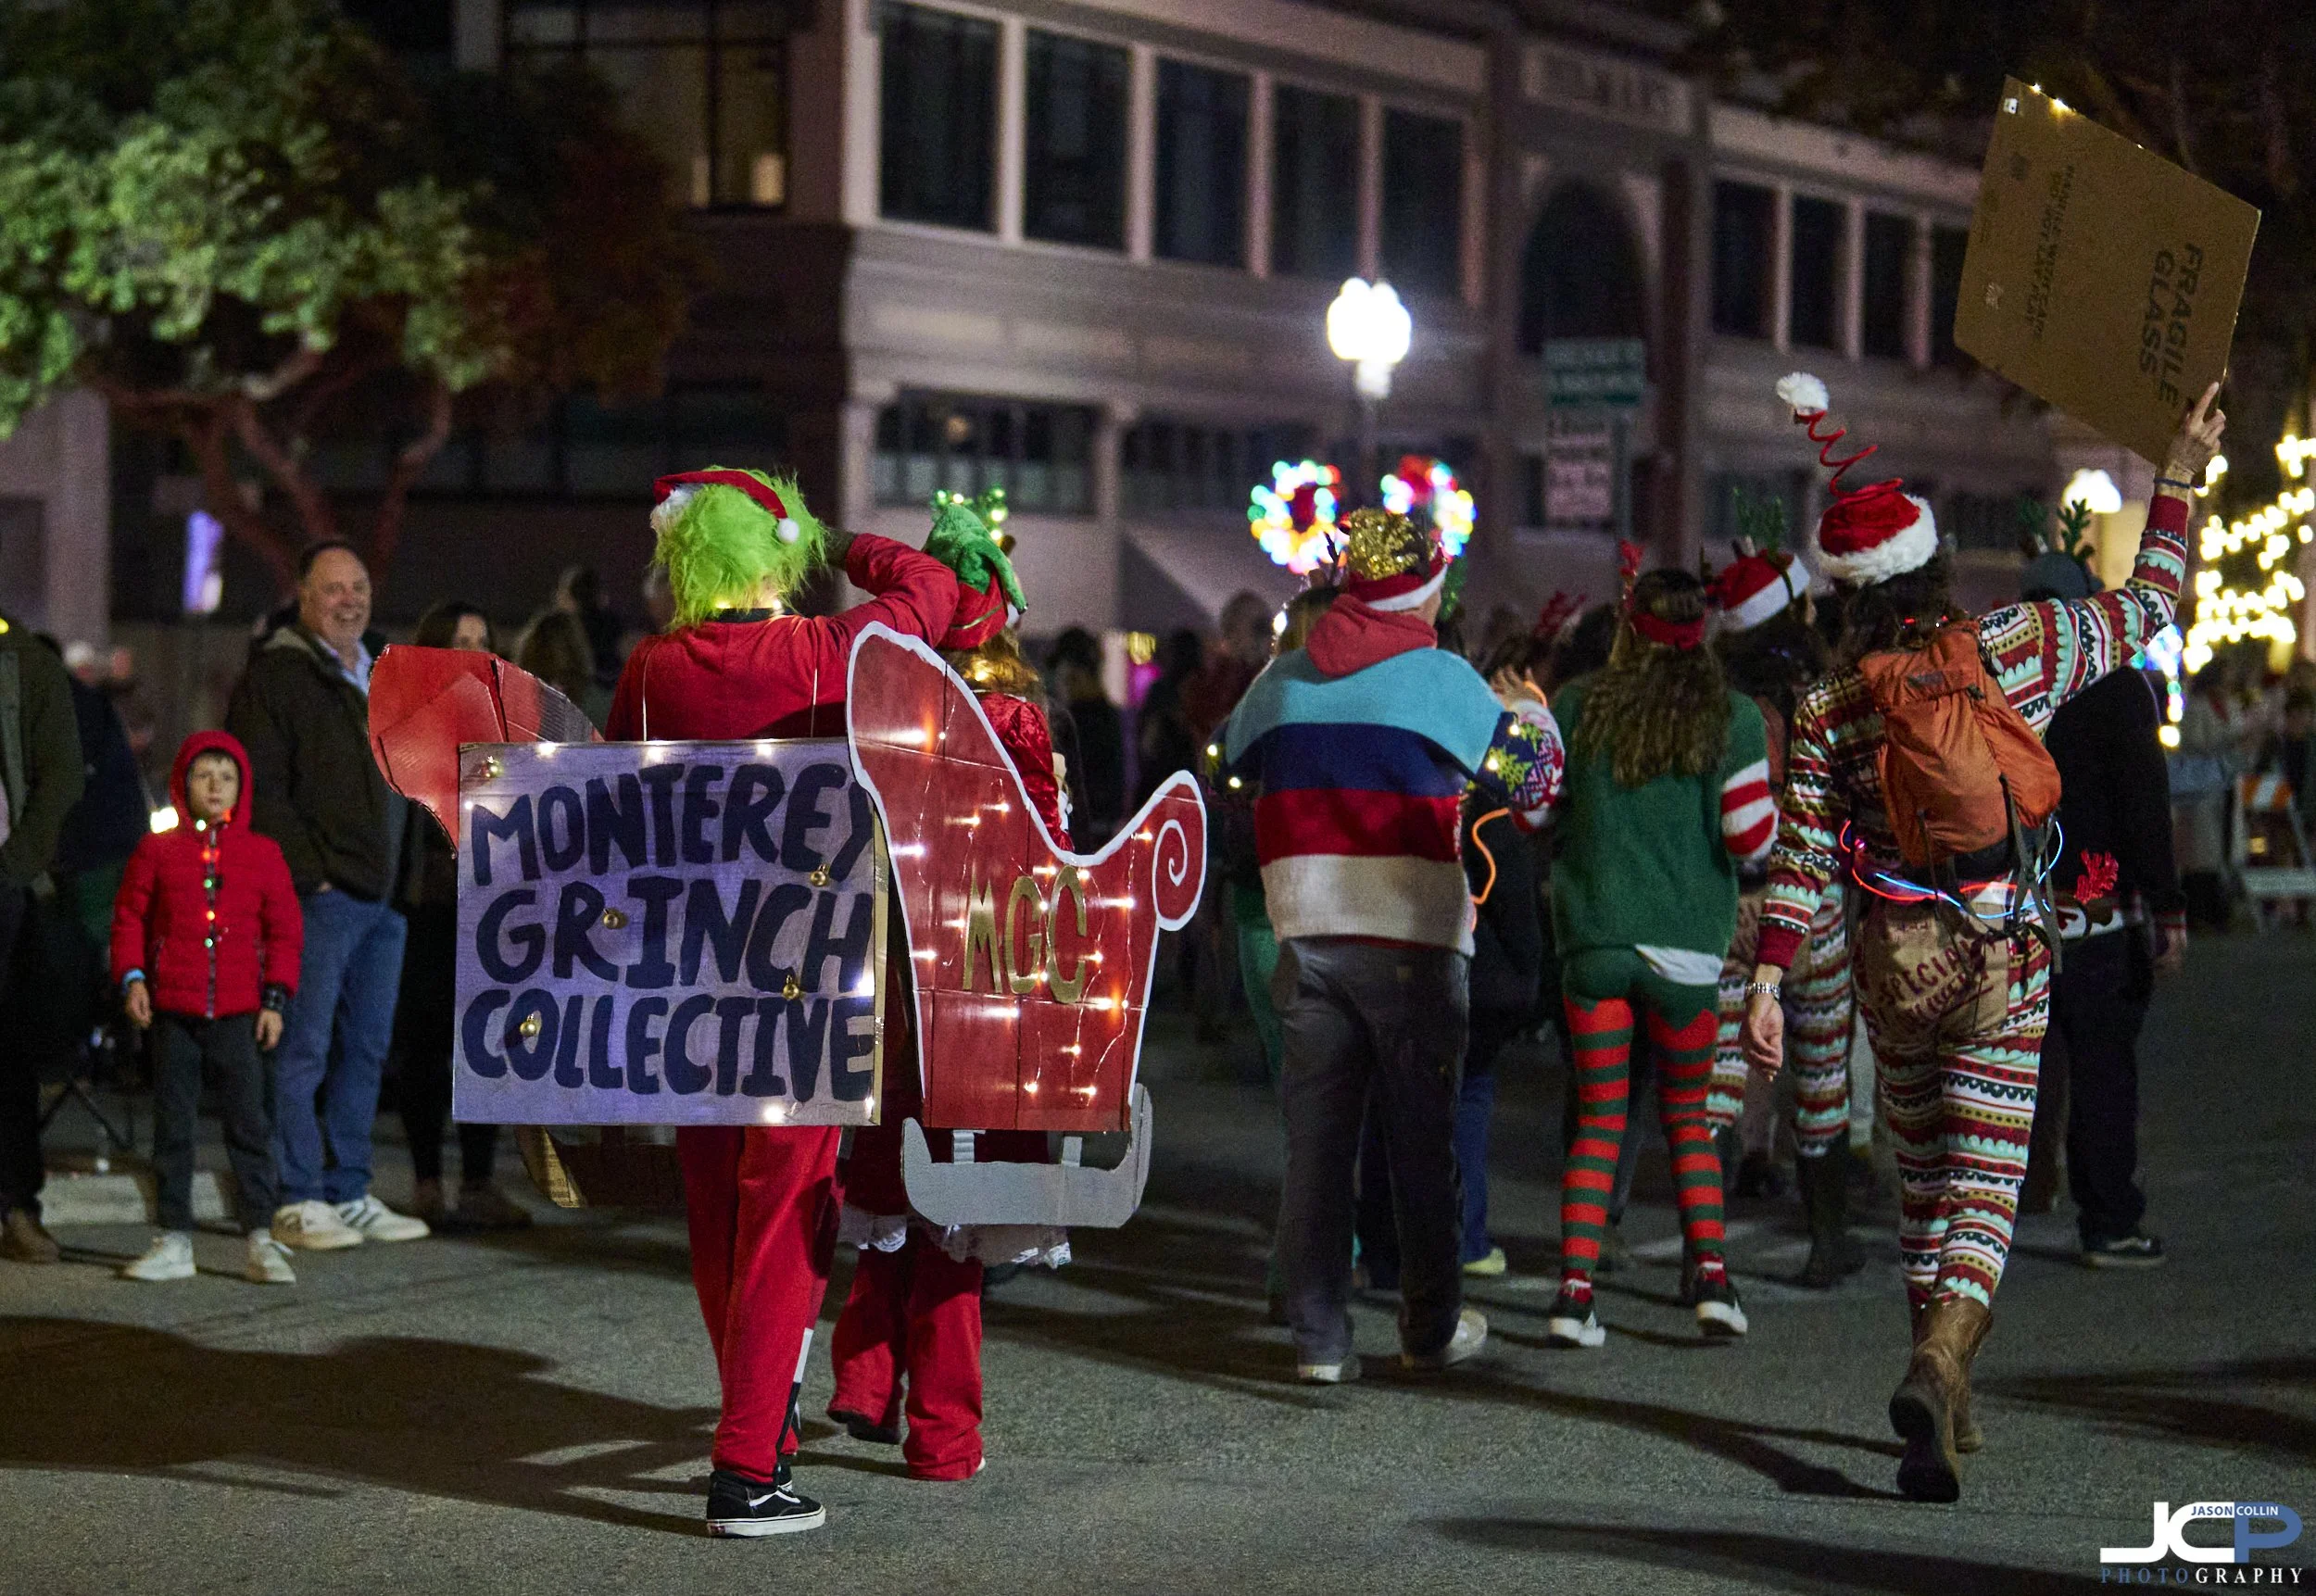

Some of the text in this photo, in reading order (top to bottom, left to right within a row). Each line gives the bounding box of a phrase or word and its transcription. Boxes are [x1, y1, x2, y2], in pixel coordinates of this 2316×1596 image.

[2139, 249, 2174, 372] GLASS
[2159, 242, 2203, 406] FRAGILE
[476, 876, 873, 993] GRINCH
[963, 860, 1087, 1004] MGC
[462, 987, 875, 1102] COLLECTIVE
